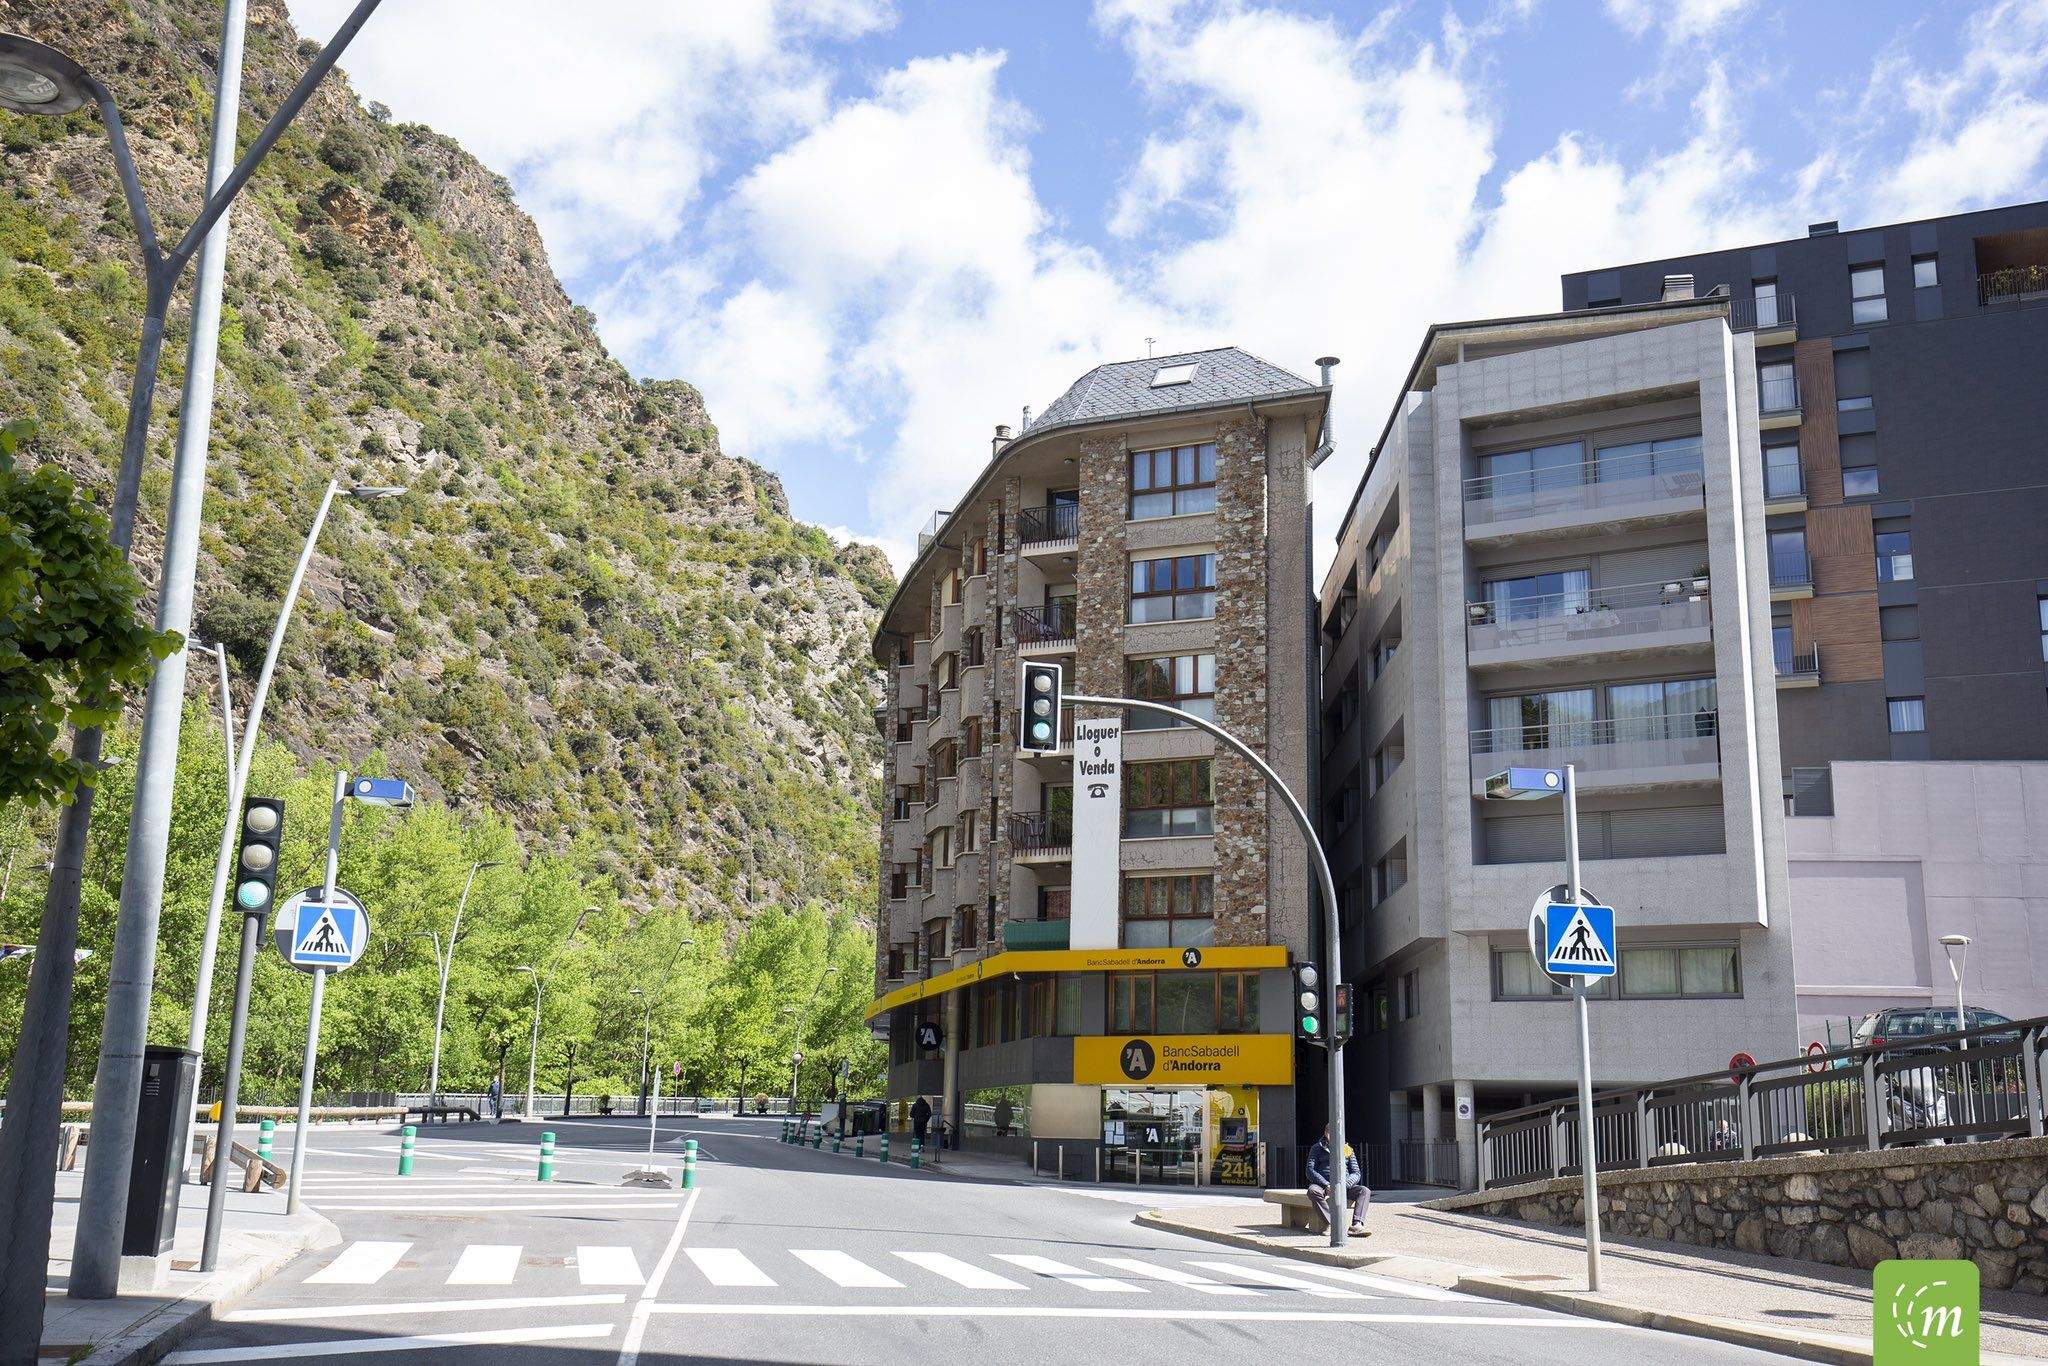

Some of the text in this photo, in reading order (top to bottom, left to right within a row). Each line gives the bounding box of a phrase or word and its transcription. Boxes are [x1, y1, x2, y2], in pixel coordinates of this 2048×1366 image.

[1077, 725, 1119, 743] Lloguer
[1094, 746, 1101, 757] o
[1079, 759, 1115, 775] Venda
[1086, 957, 1166, 966] BancSabadell d'Andorra
[1162, 1045, 1240, 1058] BancSabadell
[1162, 1060, 1221, 1072] d'Andorra
[1221, 1161, 1253, 1179] 24h
